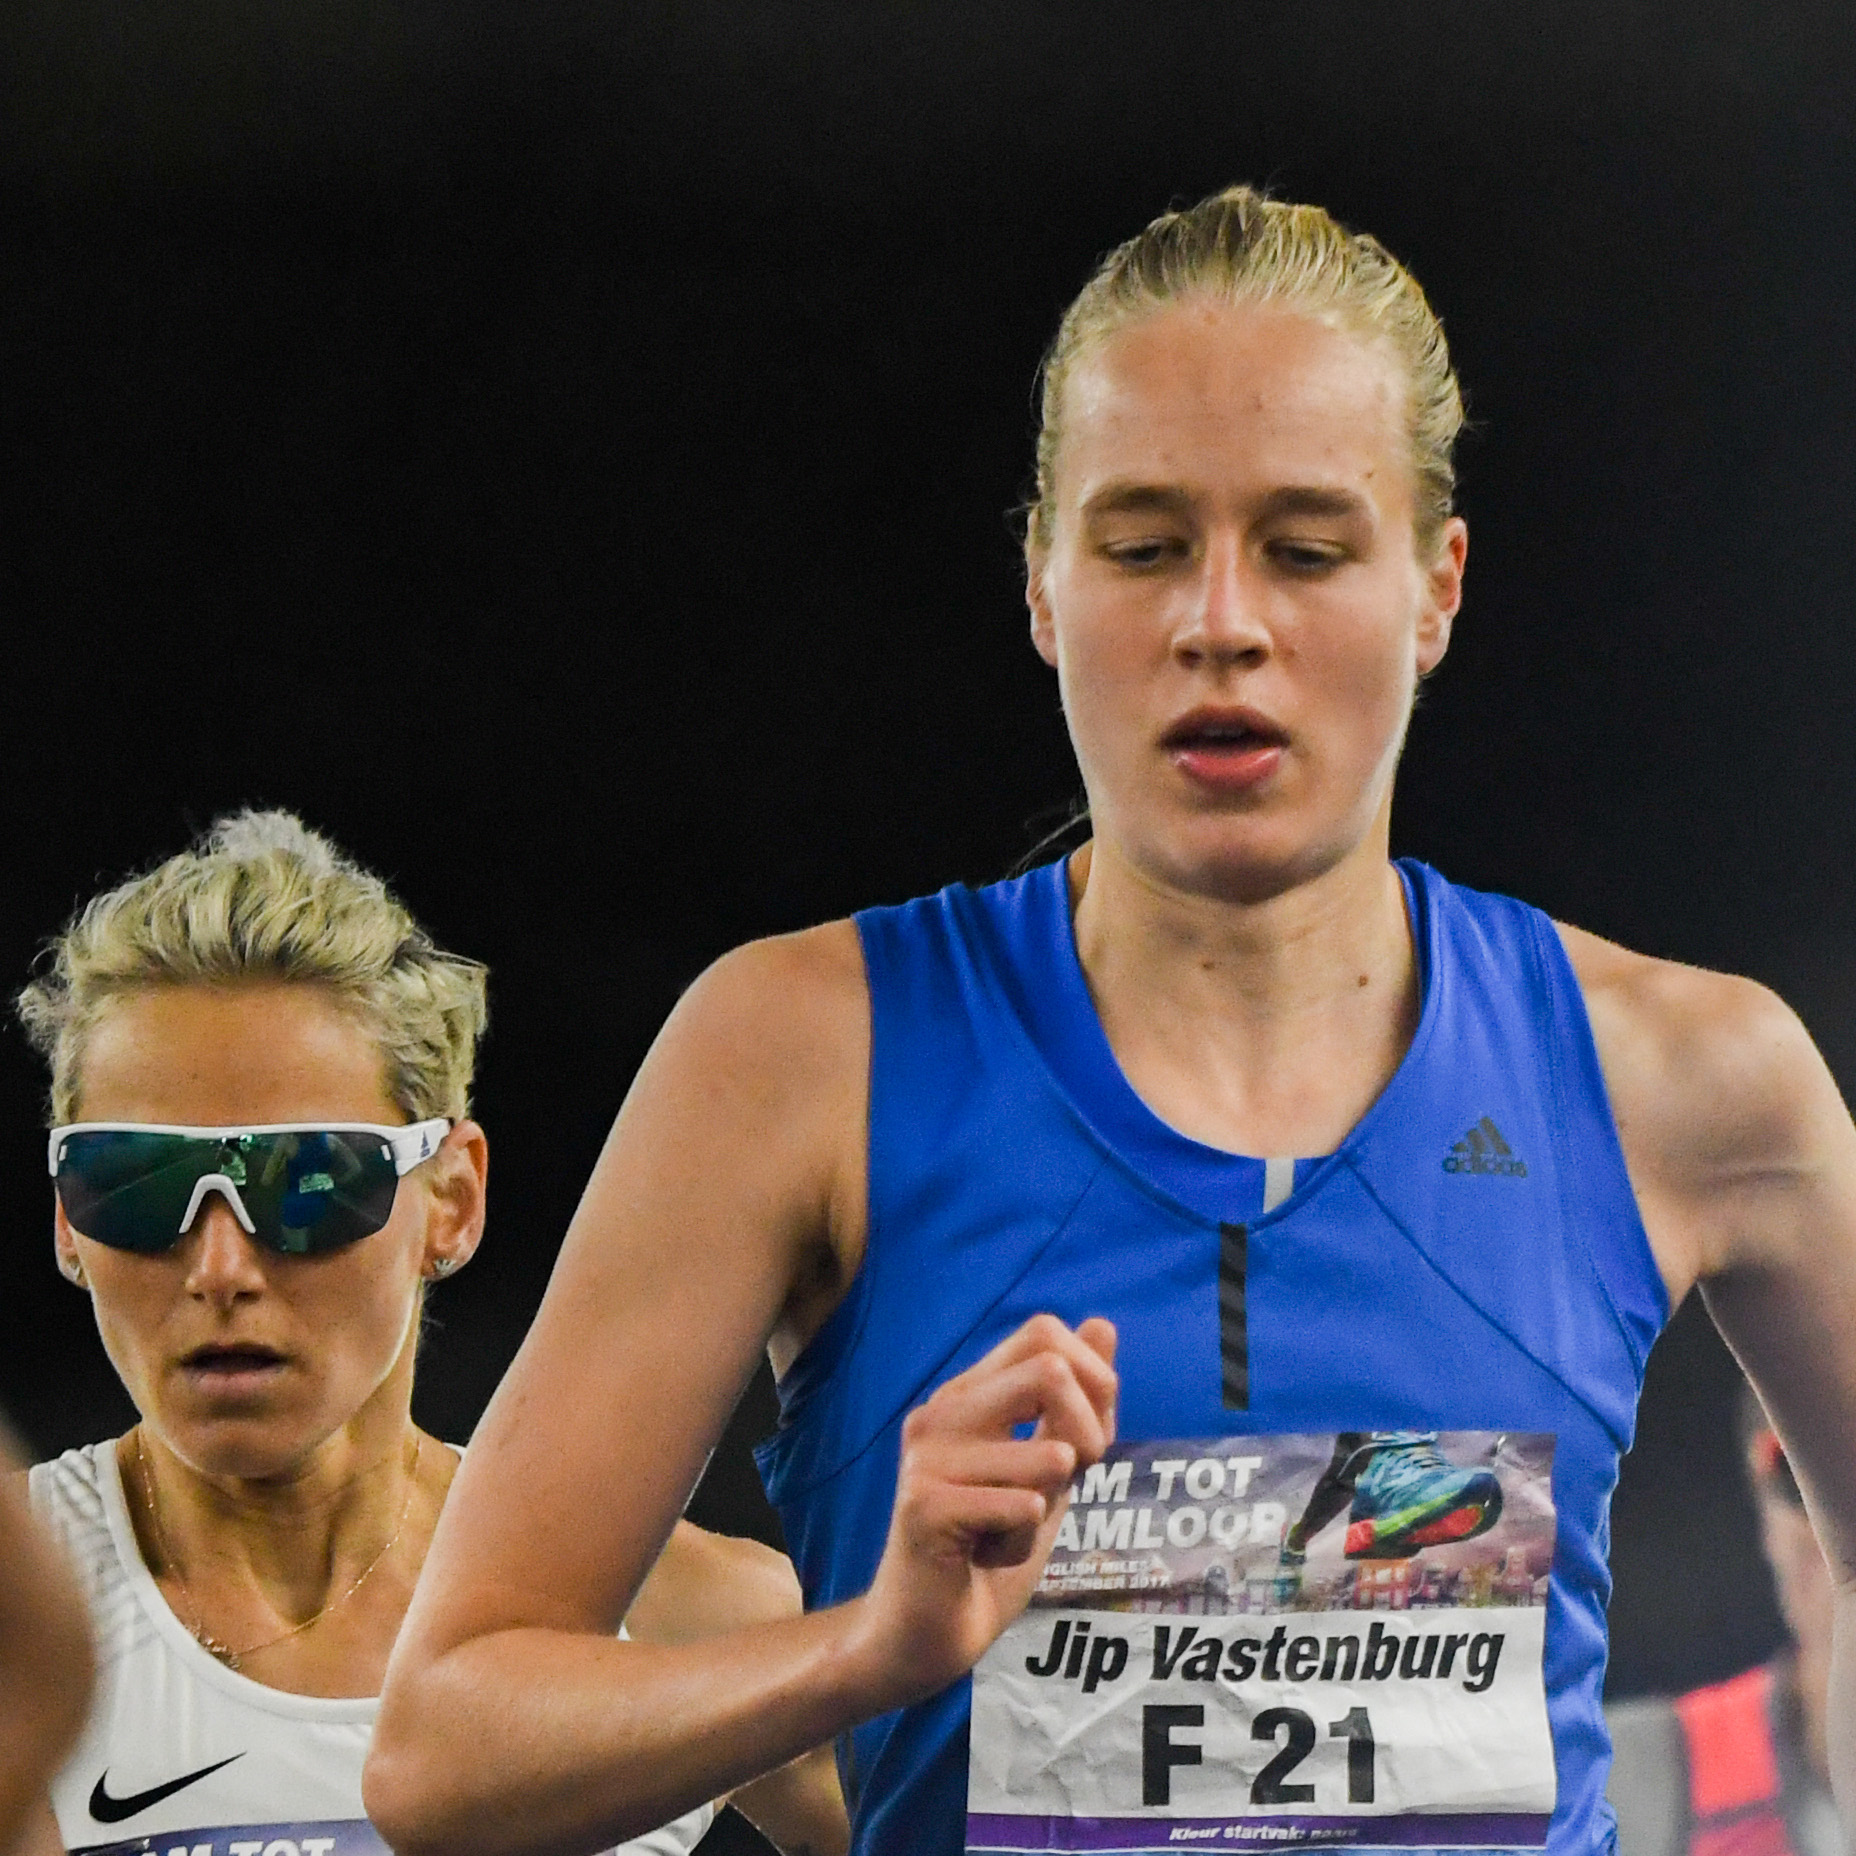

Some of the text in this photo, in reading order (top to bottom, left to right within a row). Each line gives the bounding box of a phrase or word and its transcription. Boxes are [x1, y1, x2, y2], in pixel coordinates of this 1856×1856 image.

[1151, 1456, 1262, 1501] TOT
[1052, 1502, 1286, 1551] AMLOOP
[1024, 1619, 1505, 1693] Jip Vastenburg
[1142, 1704, 1377, 1807] F 21
